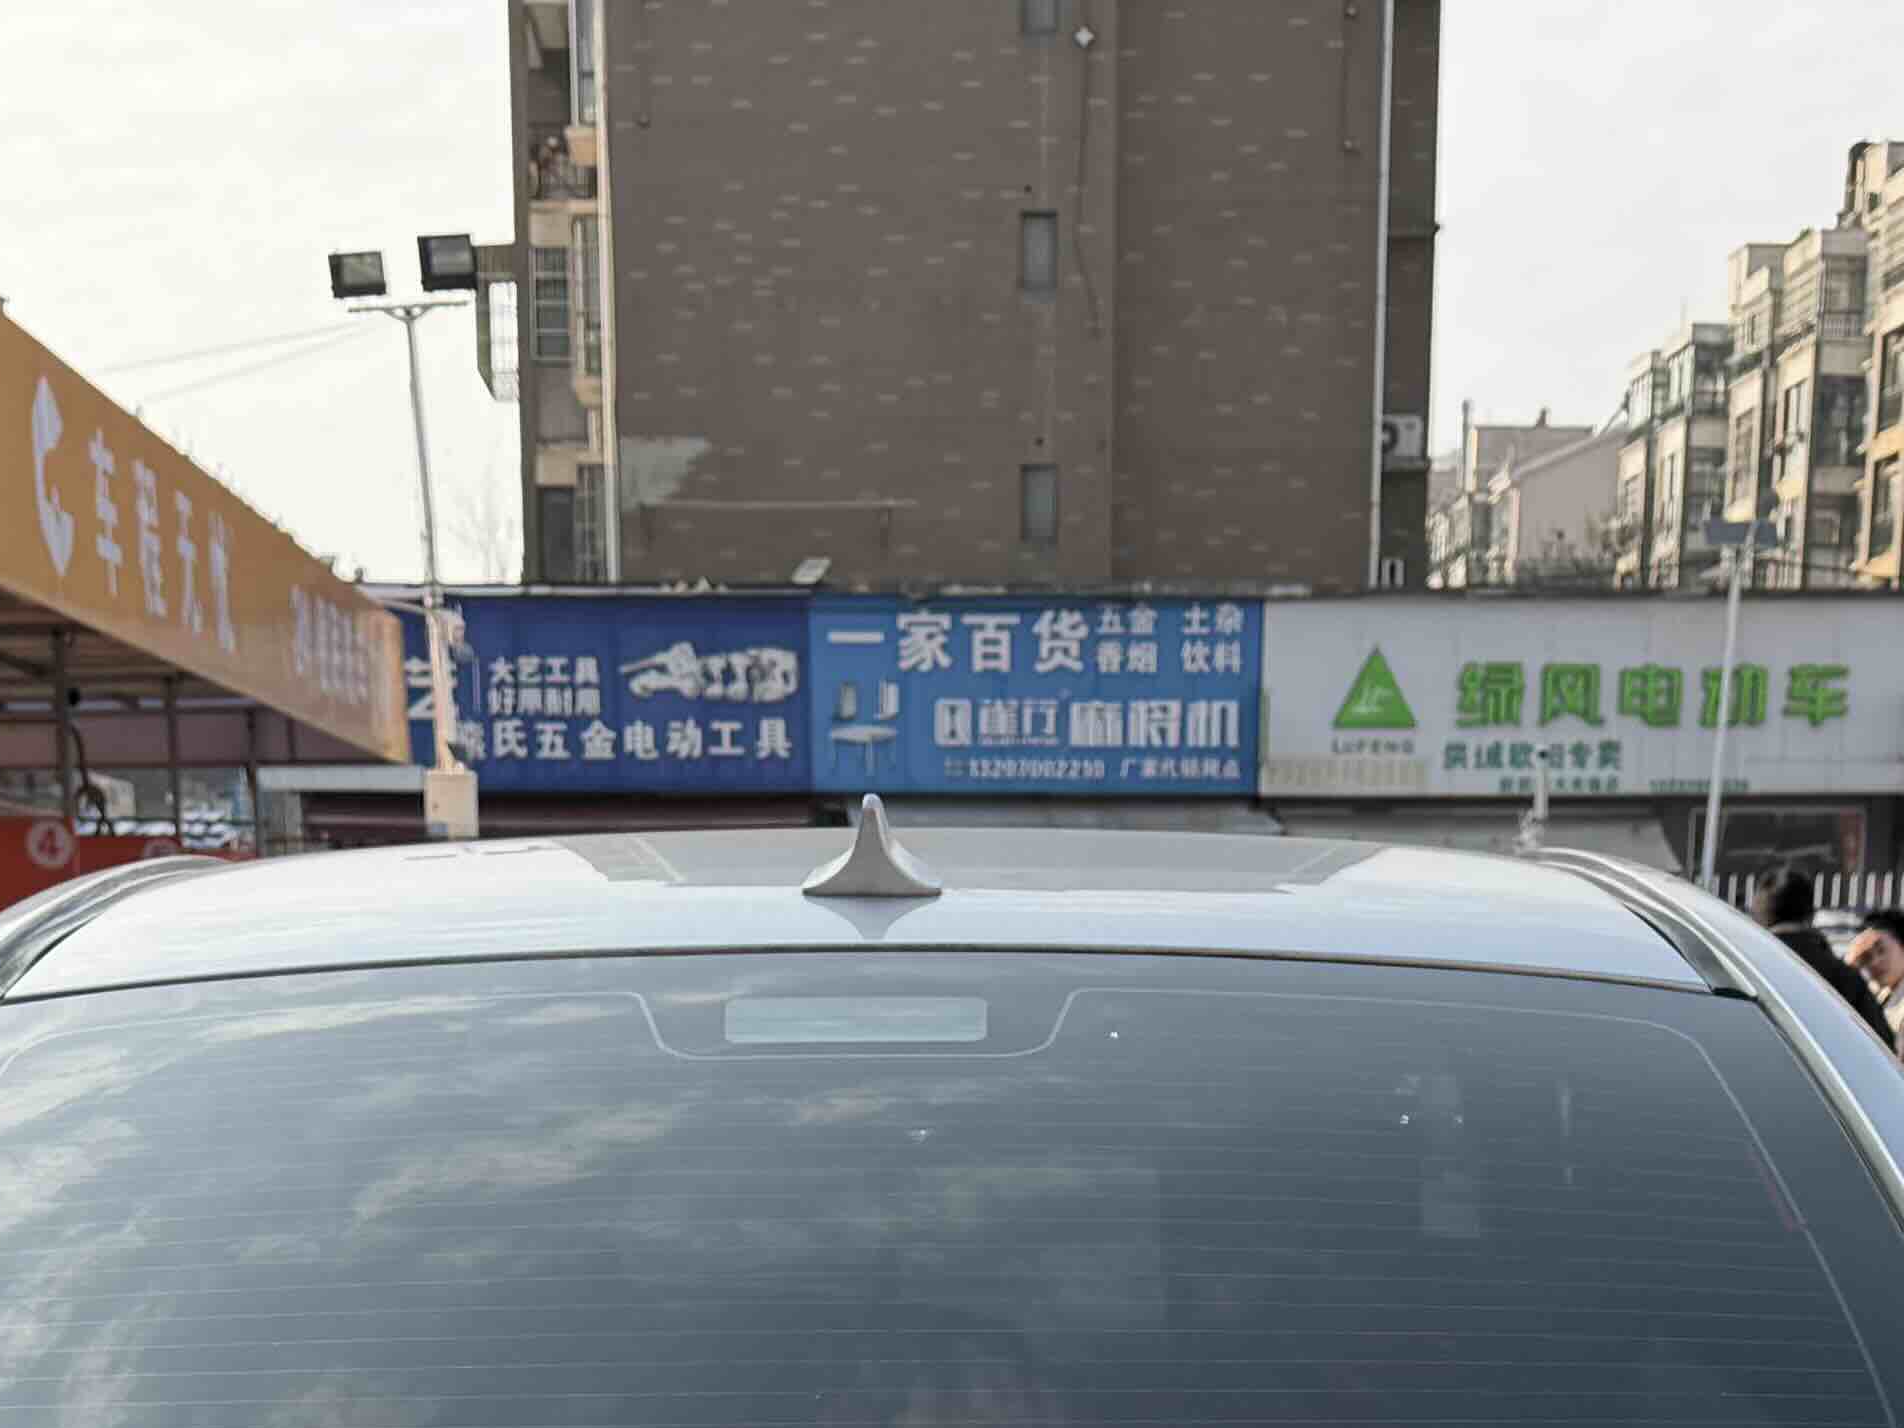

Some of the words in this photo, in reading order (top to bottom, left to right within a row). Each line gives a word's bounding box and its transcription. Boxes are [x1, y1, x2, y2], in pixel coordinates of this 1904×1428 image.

[827, 609, 1089, 674] 一家百货
[1181, 640, 1243, 674] 饮料
[1454, 663, 1851, 729] 绿风电动车
